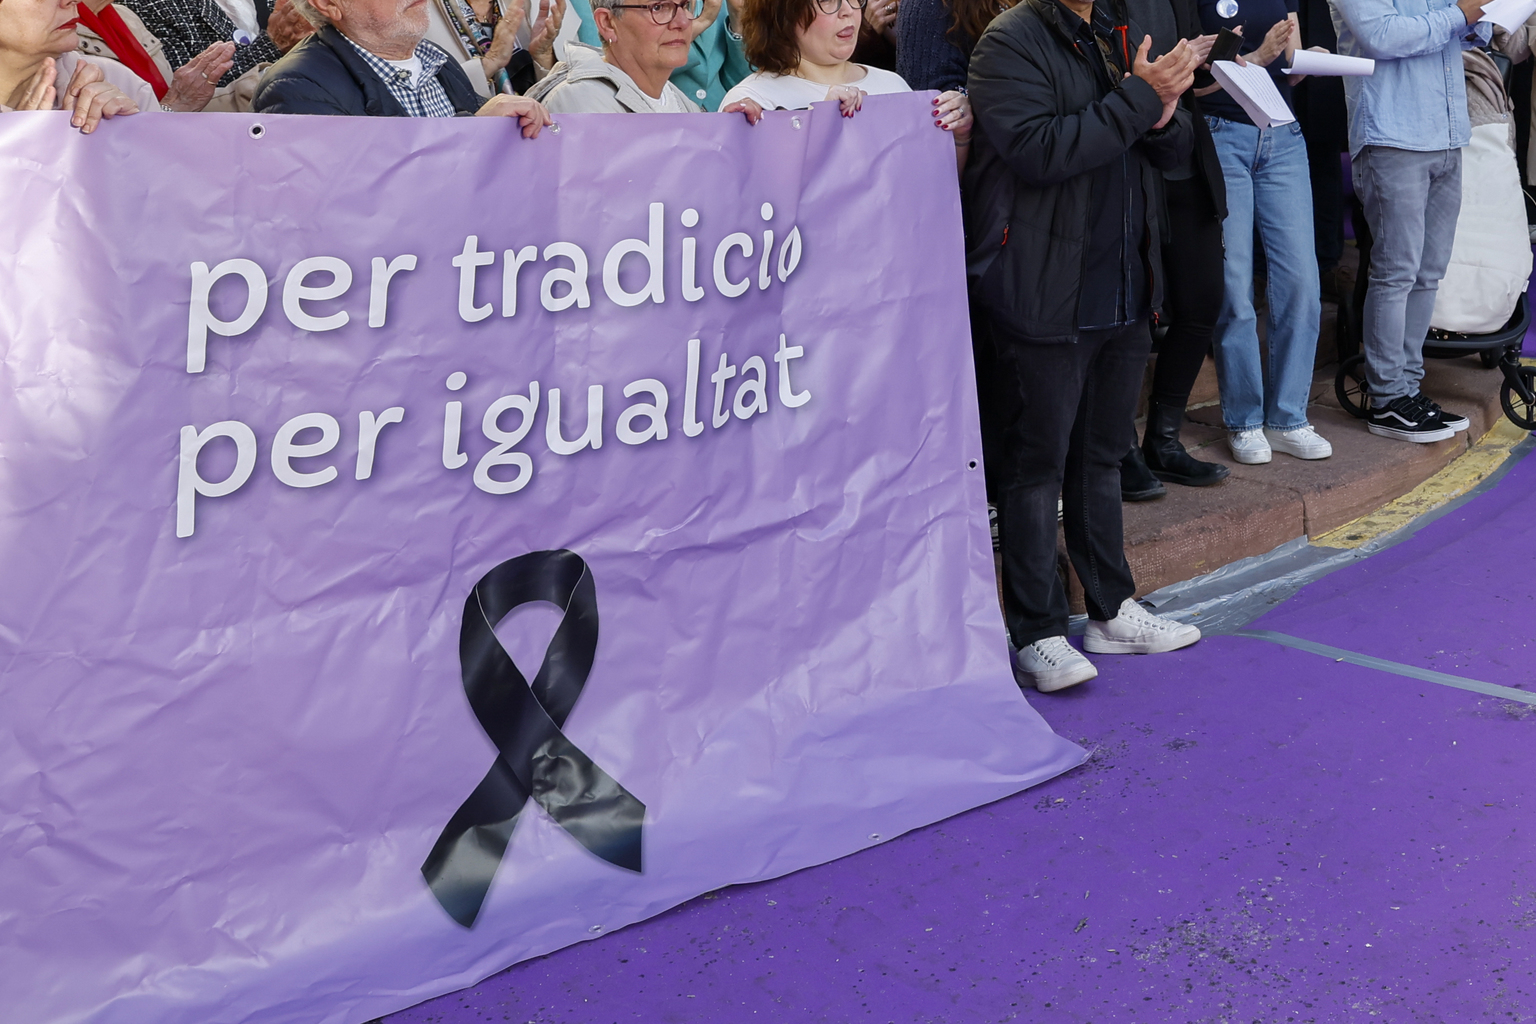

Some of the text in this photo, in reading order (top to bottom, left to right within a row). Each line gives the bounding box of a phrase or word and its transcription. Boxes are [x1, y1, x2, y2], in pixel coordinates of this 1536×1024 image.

[186, 255, 416, 373] per
[175, 332, 812, 538] per igualtat
